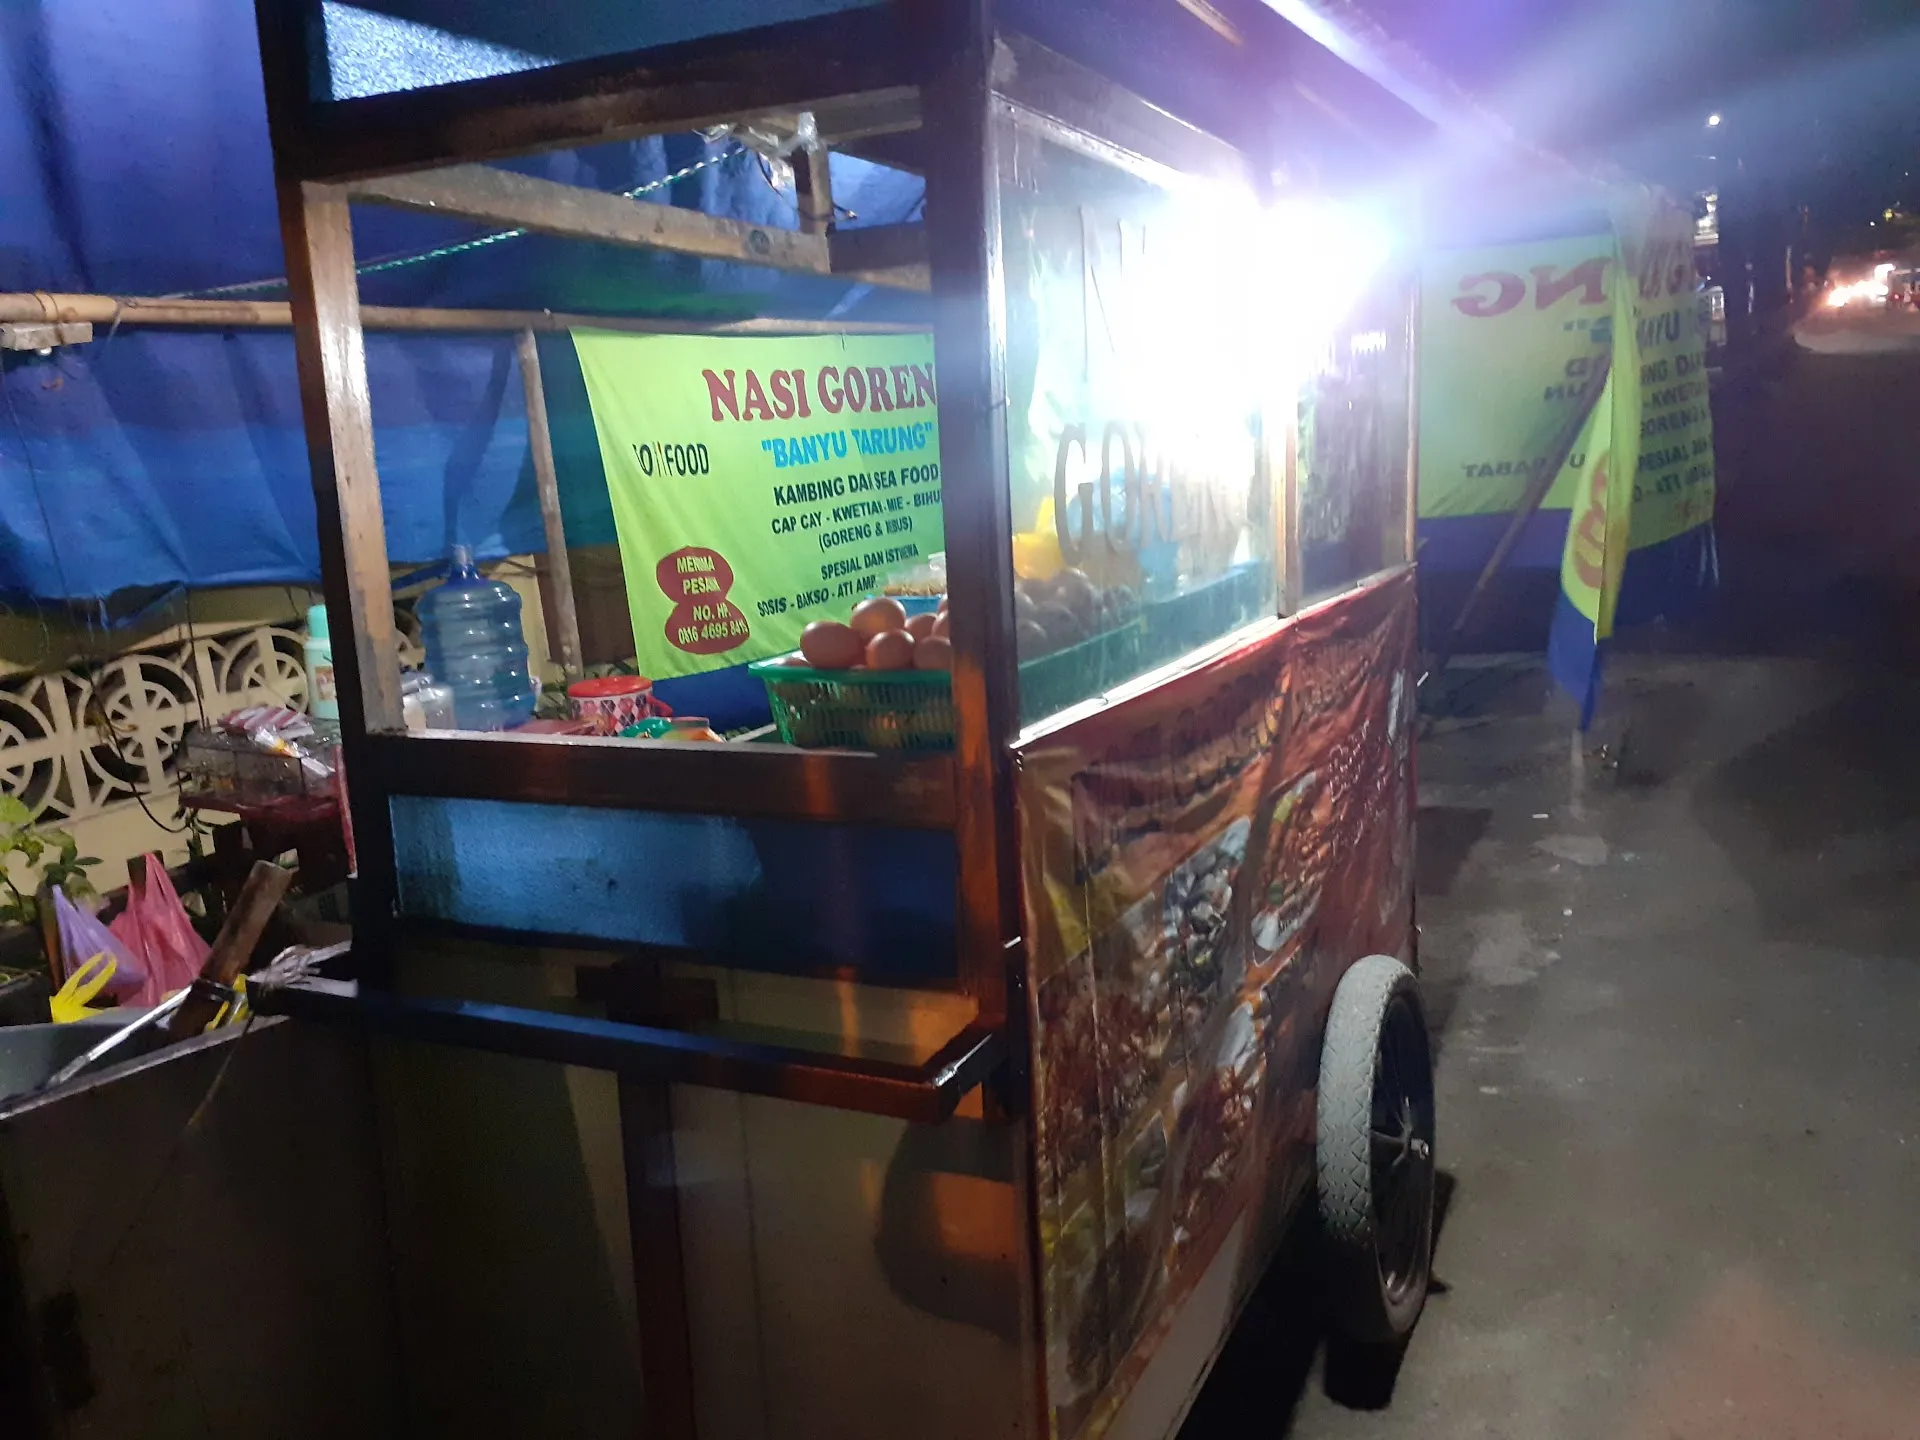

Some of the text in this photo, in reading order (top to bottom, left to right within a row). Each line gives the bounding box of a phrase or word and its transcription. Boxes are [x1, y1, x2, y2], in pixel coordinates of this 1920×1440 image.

[702, 369, 811, 422] NASI
[761, 430, 847, 468] "BANYU
[773, 477, 845, 506] KAMBING
[874, 470, 897, 490] SEA
[901, 463, 939, 486] FOOD
[771, 516, 797, 534] CAP
[801, 511, 822, 530] CAY
[875, 522, 883, 537] &
[821, 555, 863, 580] SPESIAL
[864, 551, 884, 568] DAN
[693, 604, 715, 621] NO.
[757, 597, 787, 617] SOSIS
[796, 588, 829, 609] BAKSO
[837, 581, 853, 598] ATI
[701, 621, 729, 640] 4695
